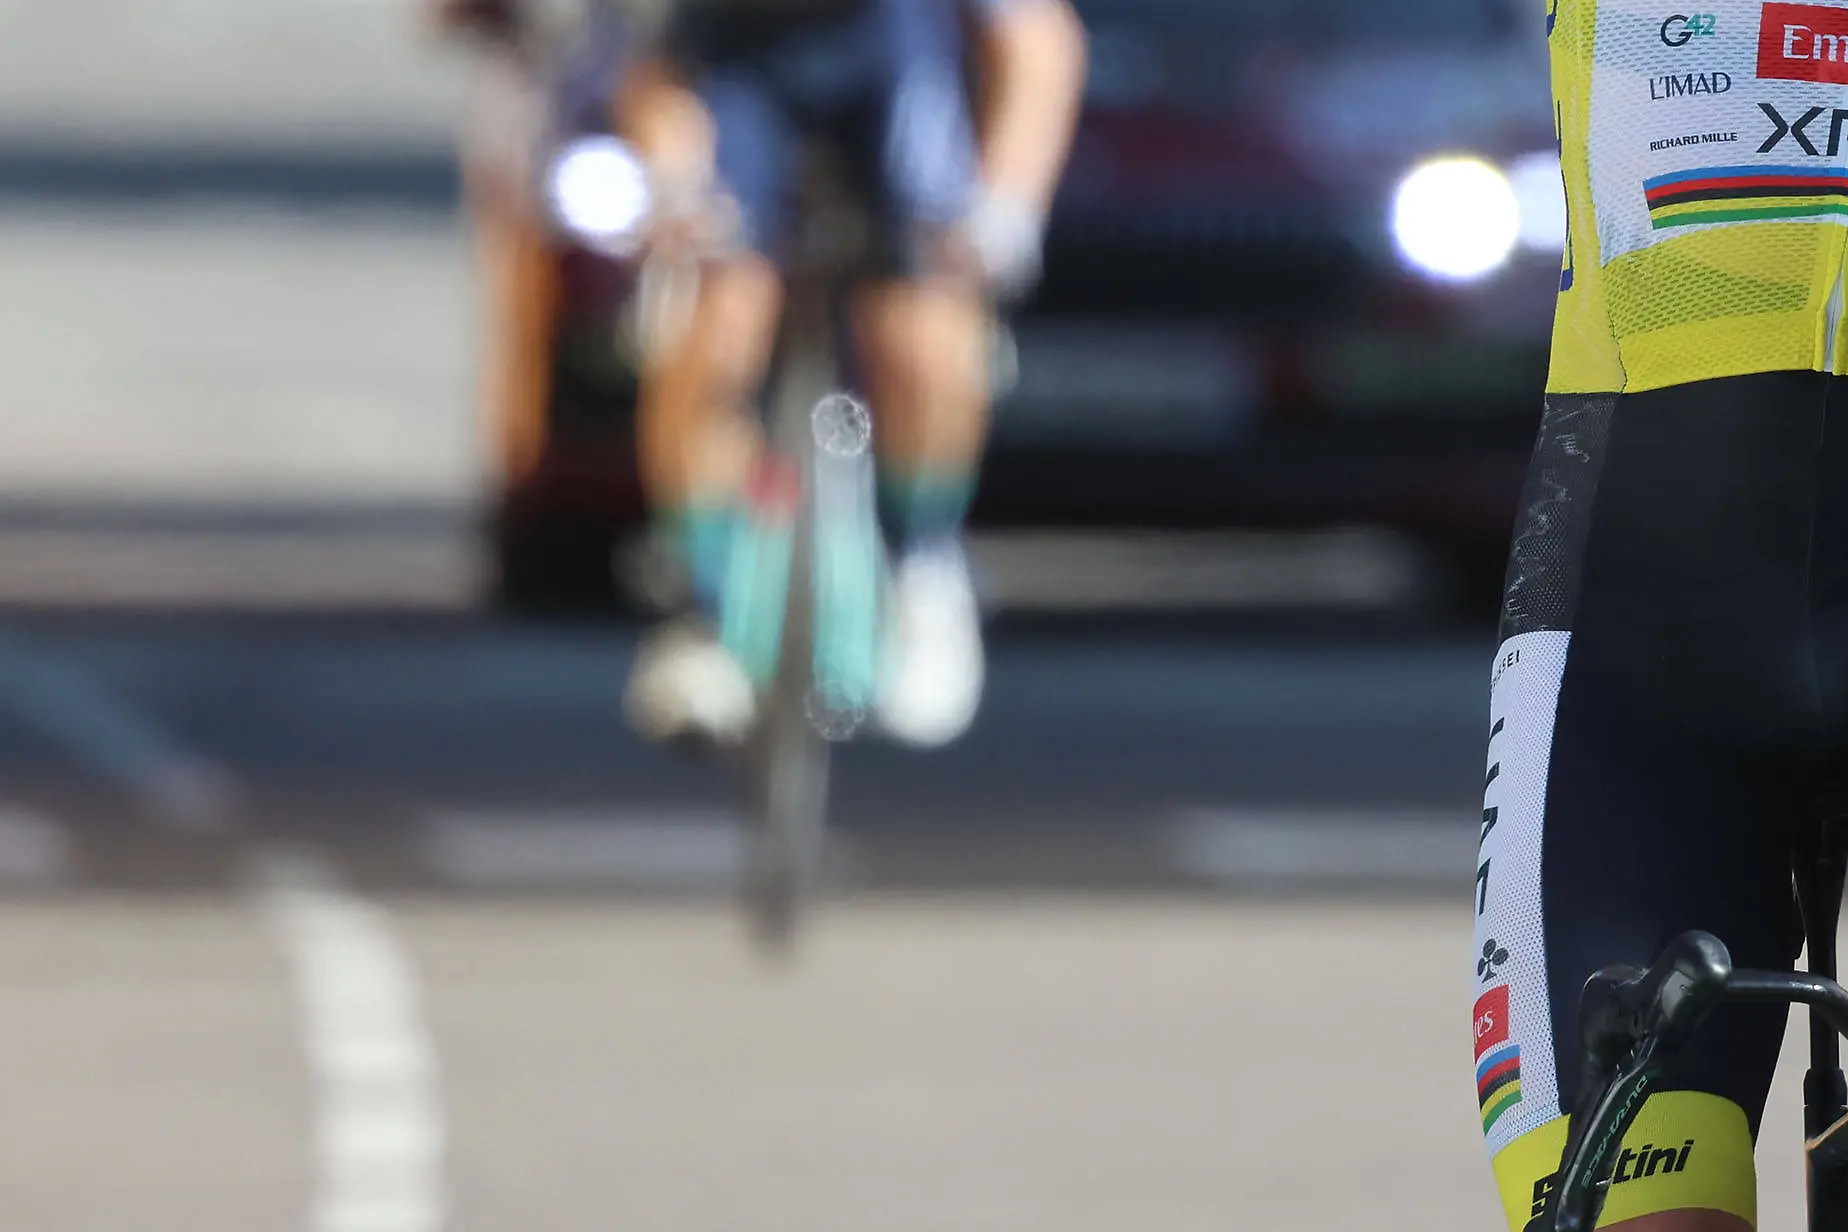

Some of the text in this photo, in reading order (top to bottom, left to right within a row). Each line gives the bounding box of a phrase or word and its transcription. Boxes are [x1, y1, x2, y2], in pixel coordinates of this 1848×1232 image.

[1660, 13, 1717, 48] G42
[1649, 71, 1732, 101] L'IMAD
[1649, 131, 1738, 152] RICHARD MILLE
[1531, 1139, 1695, 1220] Stini
